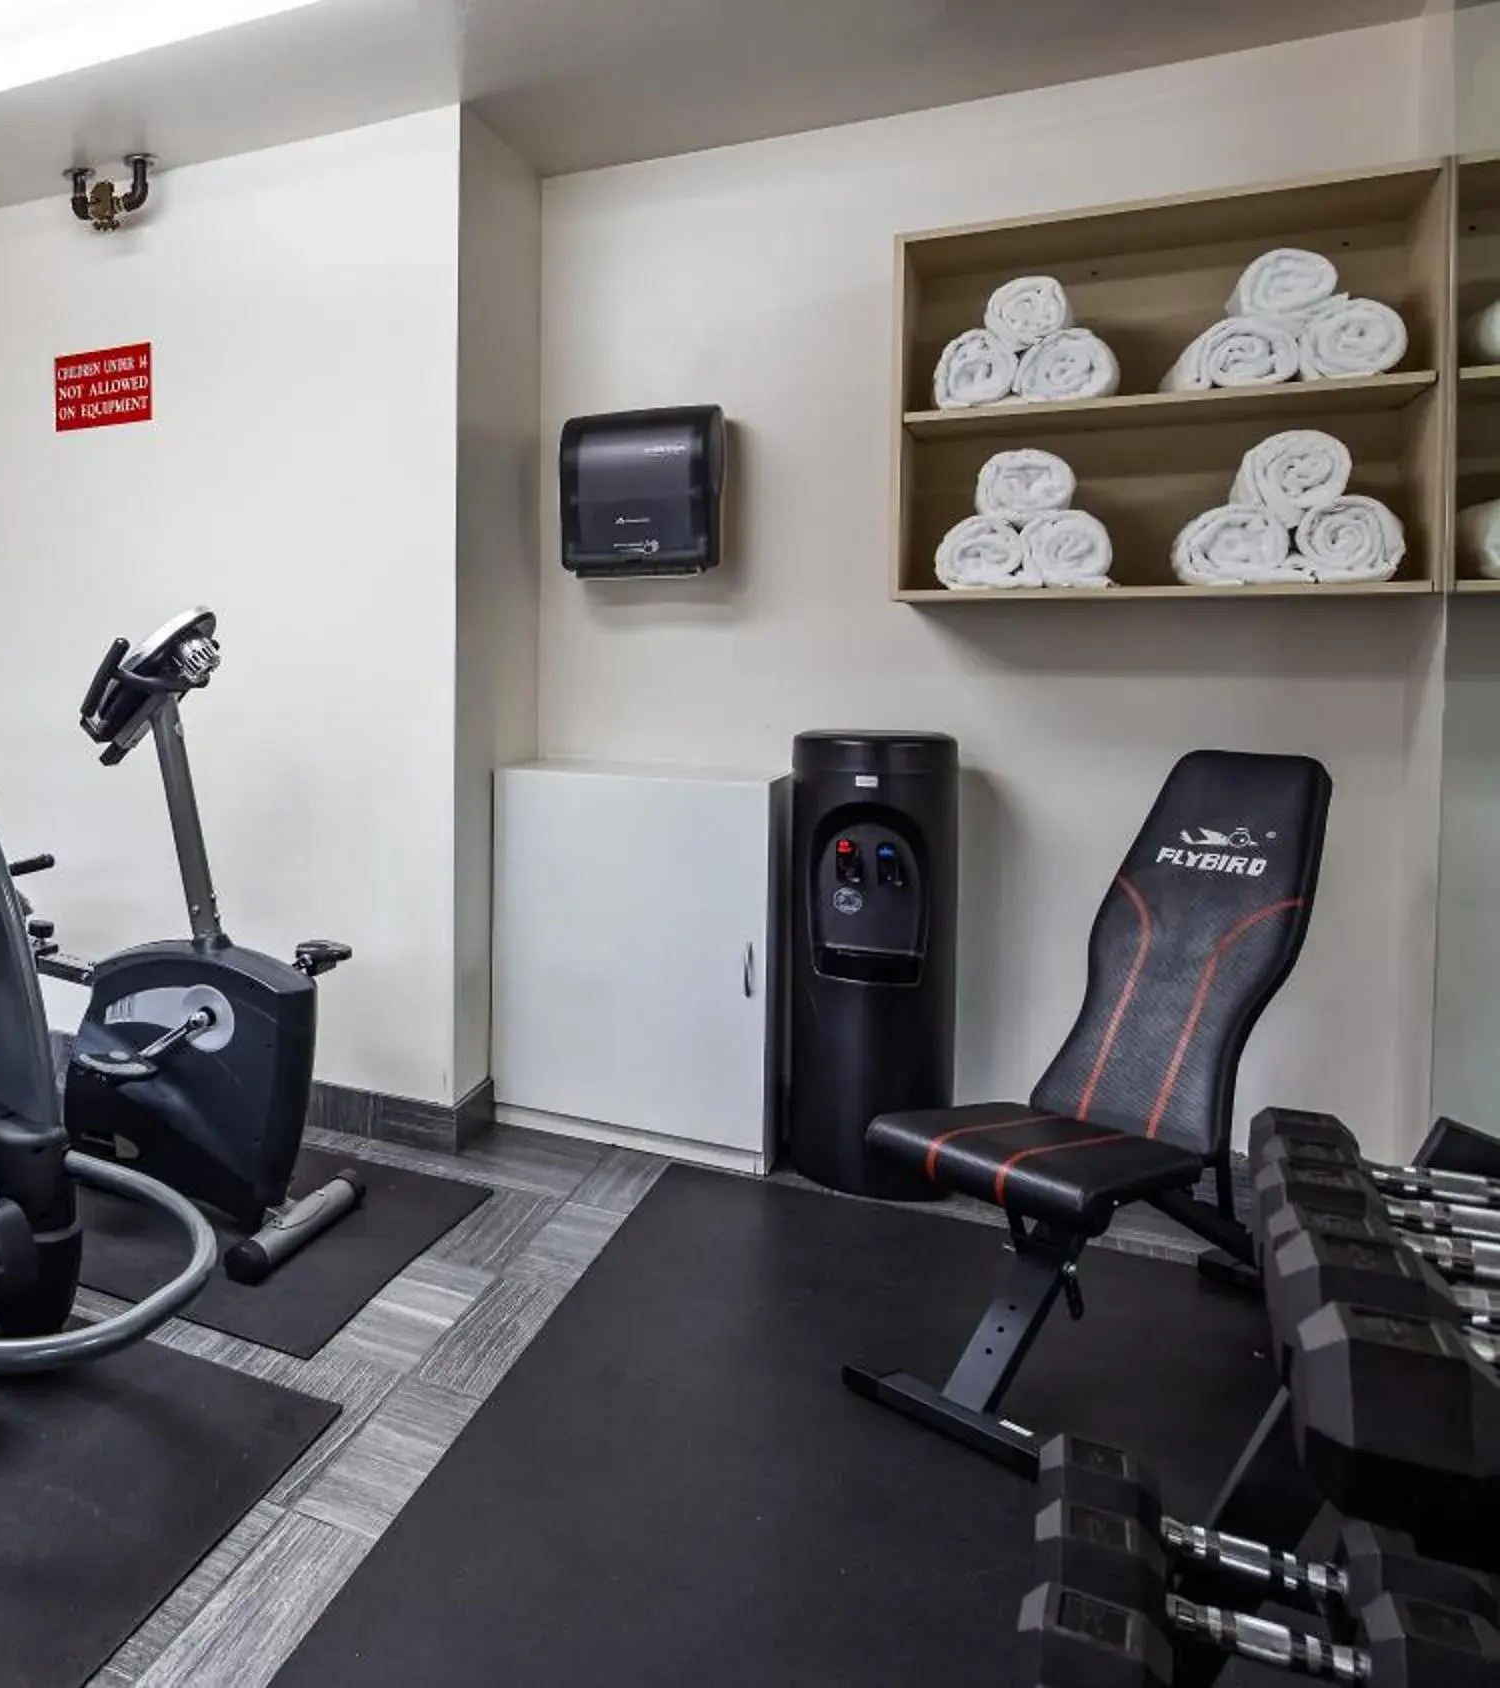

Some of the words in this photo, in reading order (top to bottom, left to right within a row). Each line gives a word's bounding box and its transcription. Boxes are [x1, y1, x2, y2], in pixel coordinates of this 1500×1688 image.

[57, 361, 100, 381] CHILDREN
[103, 356, 135, 374] UNDER
[58, 384, 85, 401] NOT
[89, 375, 148, 397] ALLOWED
[58, 405, 76, 421] ON
[81, 395, 148, 419] EQUIPMENT
[1155, 846, 1267, 877] FLYBIRD
